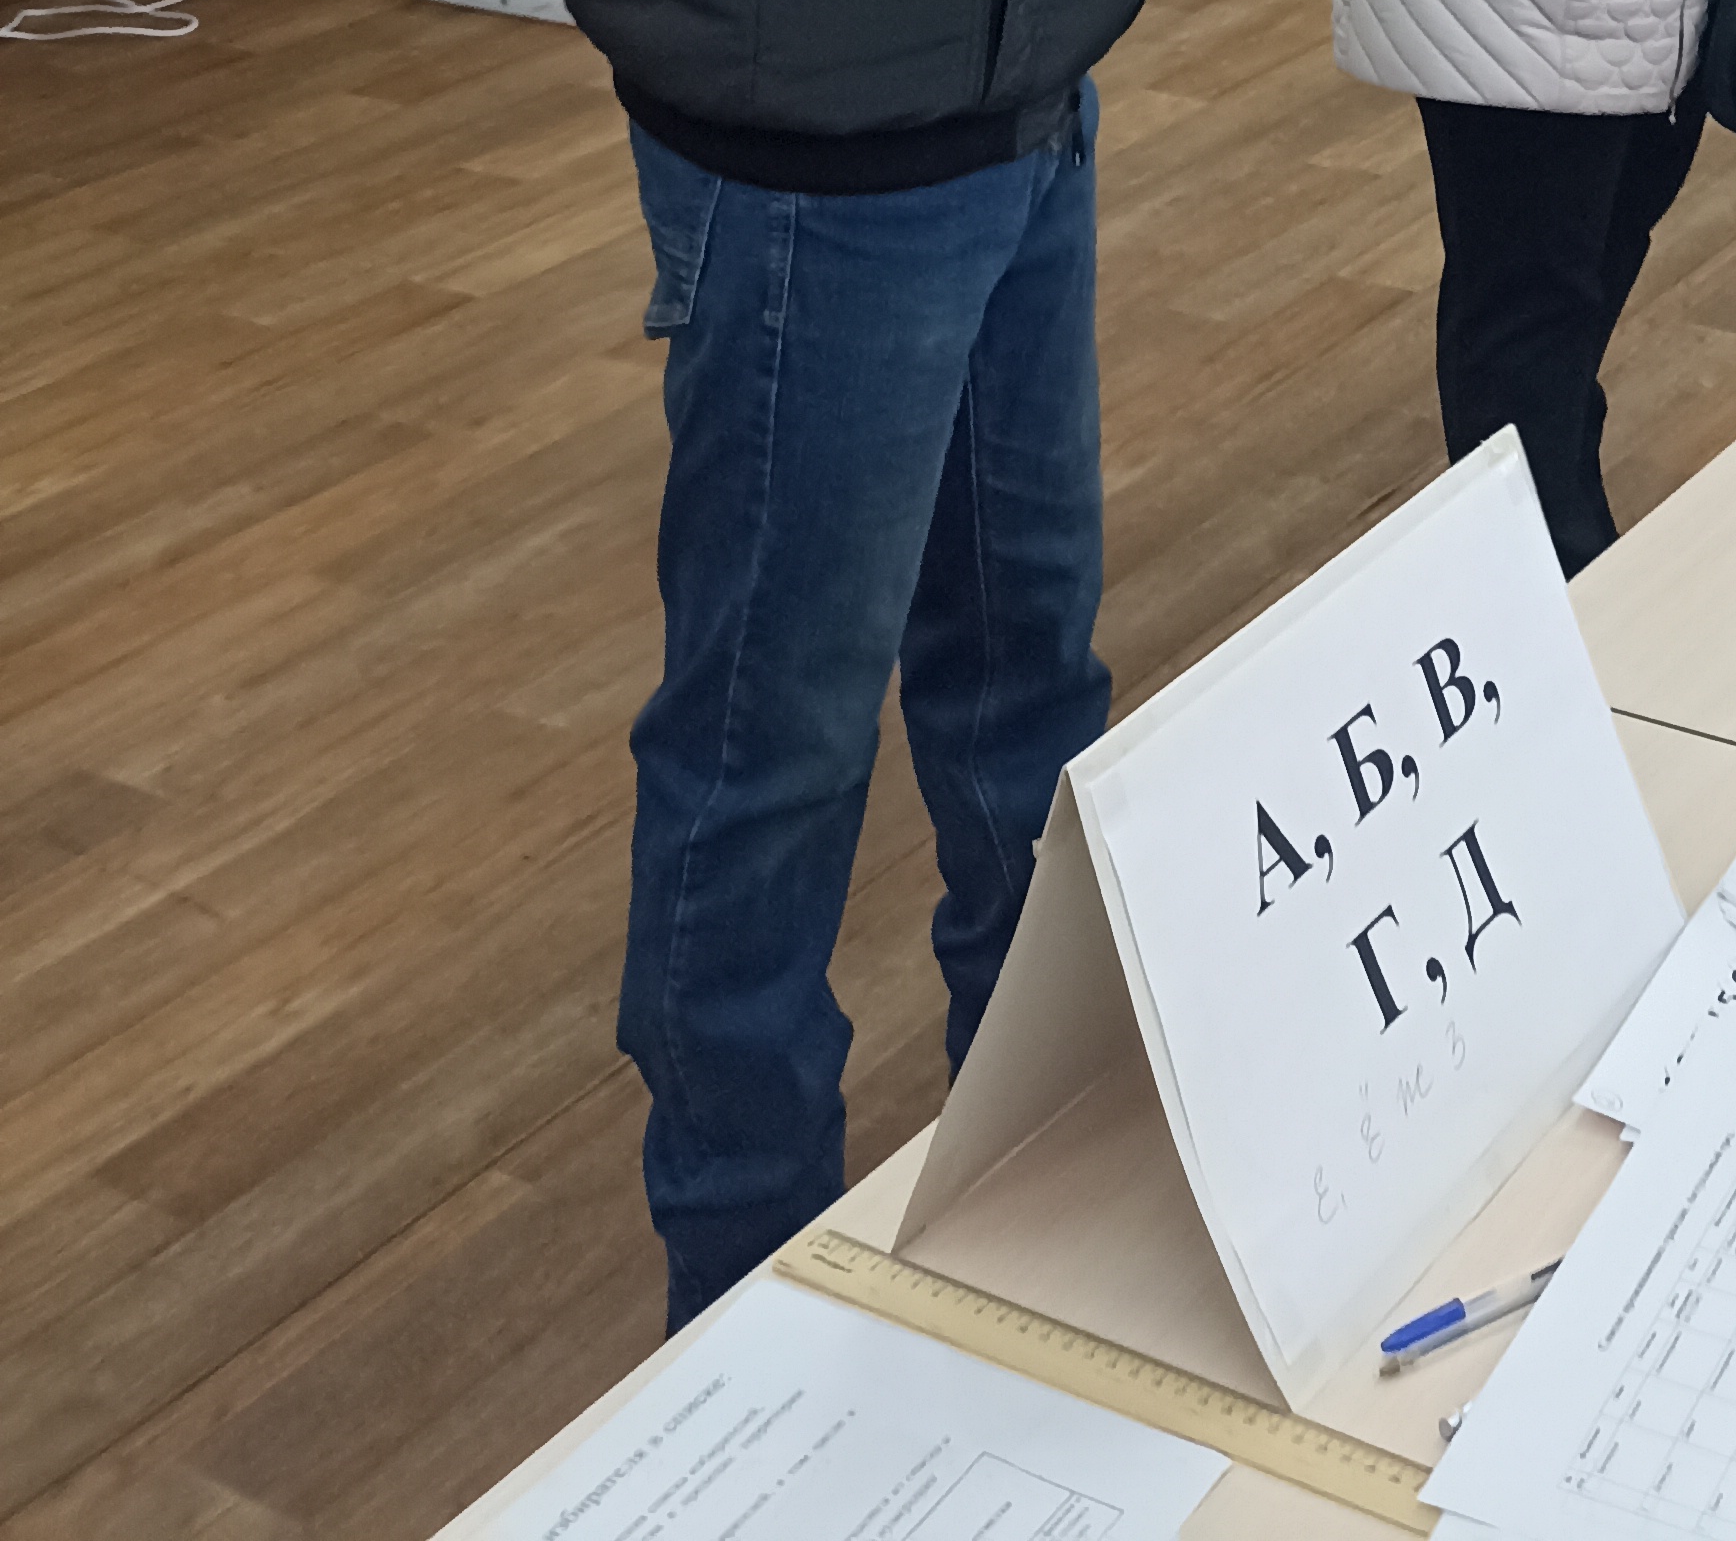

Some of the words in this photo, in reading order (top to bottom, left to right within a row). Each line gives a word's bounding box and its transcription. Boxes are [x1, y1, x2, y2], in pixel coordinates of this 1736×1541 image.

[1255, 800, 1334, 915] А,
[1328, 702, 1421, 826] Б,
[1413, 636, 1503, 748] В,
[1438, 819, 1523, 974] Д
